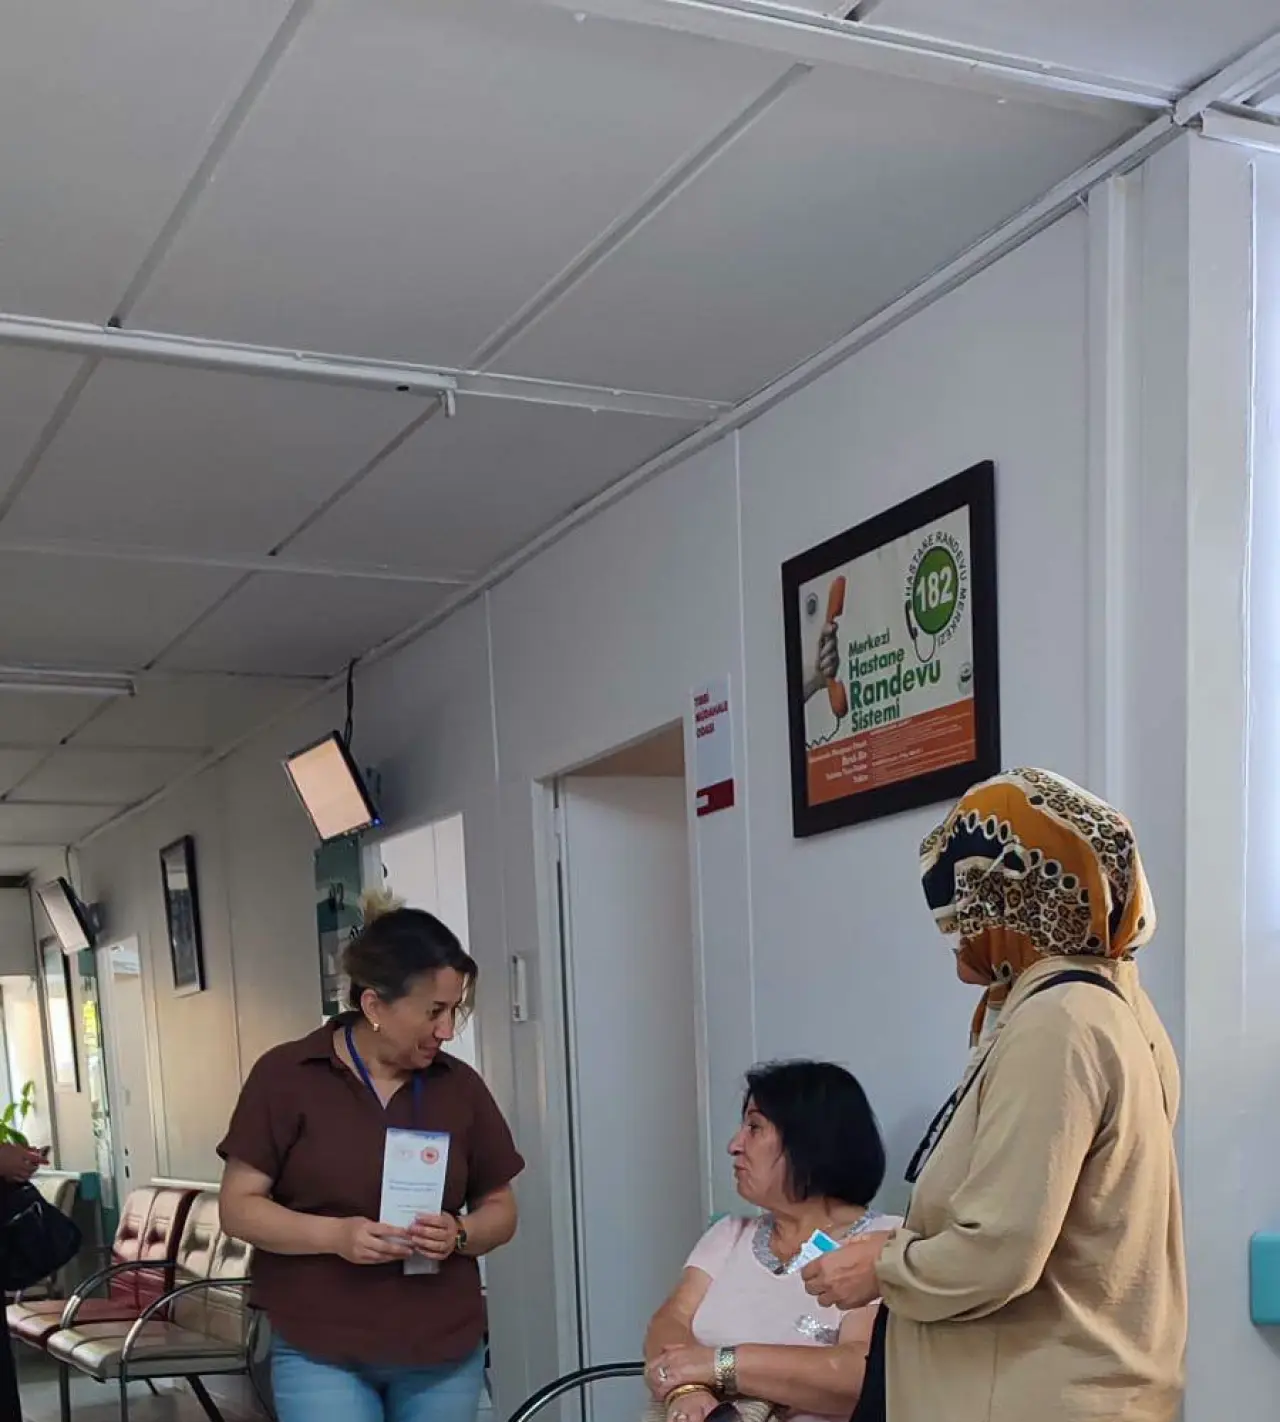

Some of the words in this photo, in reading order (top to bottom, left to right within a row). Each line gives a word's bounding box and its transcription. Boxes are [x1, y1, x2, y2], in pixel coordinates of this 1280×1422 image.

[936, 531, 968, 581] RANDEVU
[916, 566, 953, 612] 182
[849, 627, 890, 657] Merkezi
[849, 648, 905, 680] Hastane
[850, 660, 941, 710] Randevu
[851, 697, 900, 732] Sistemi
